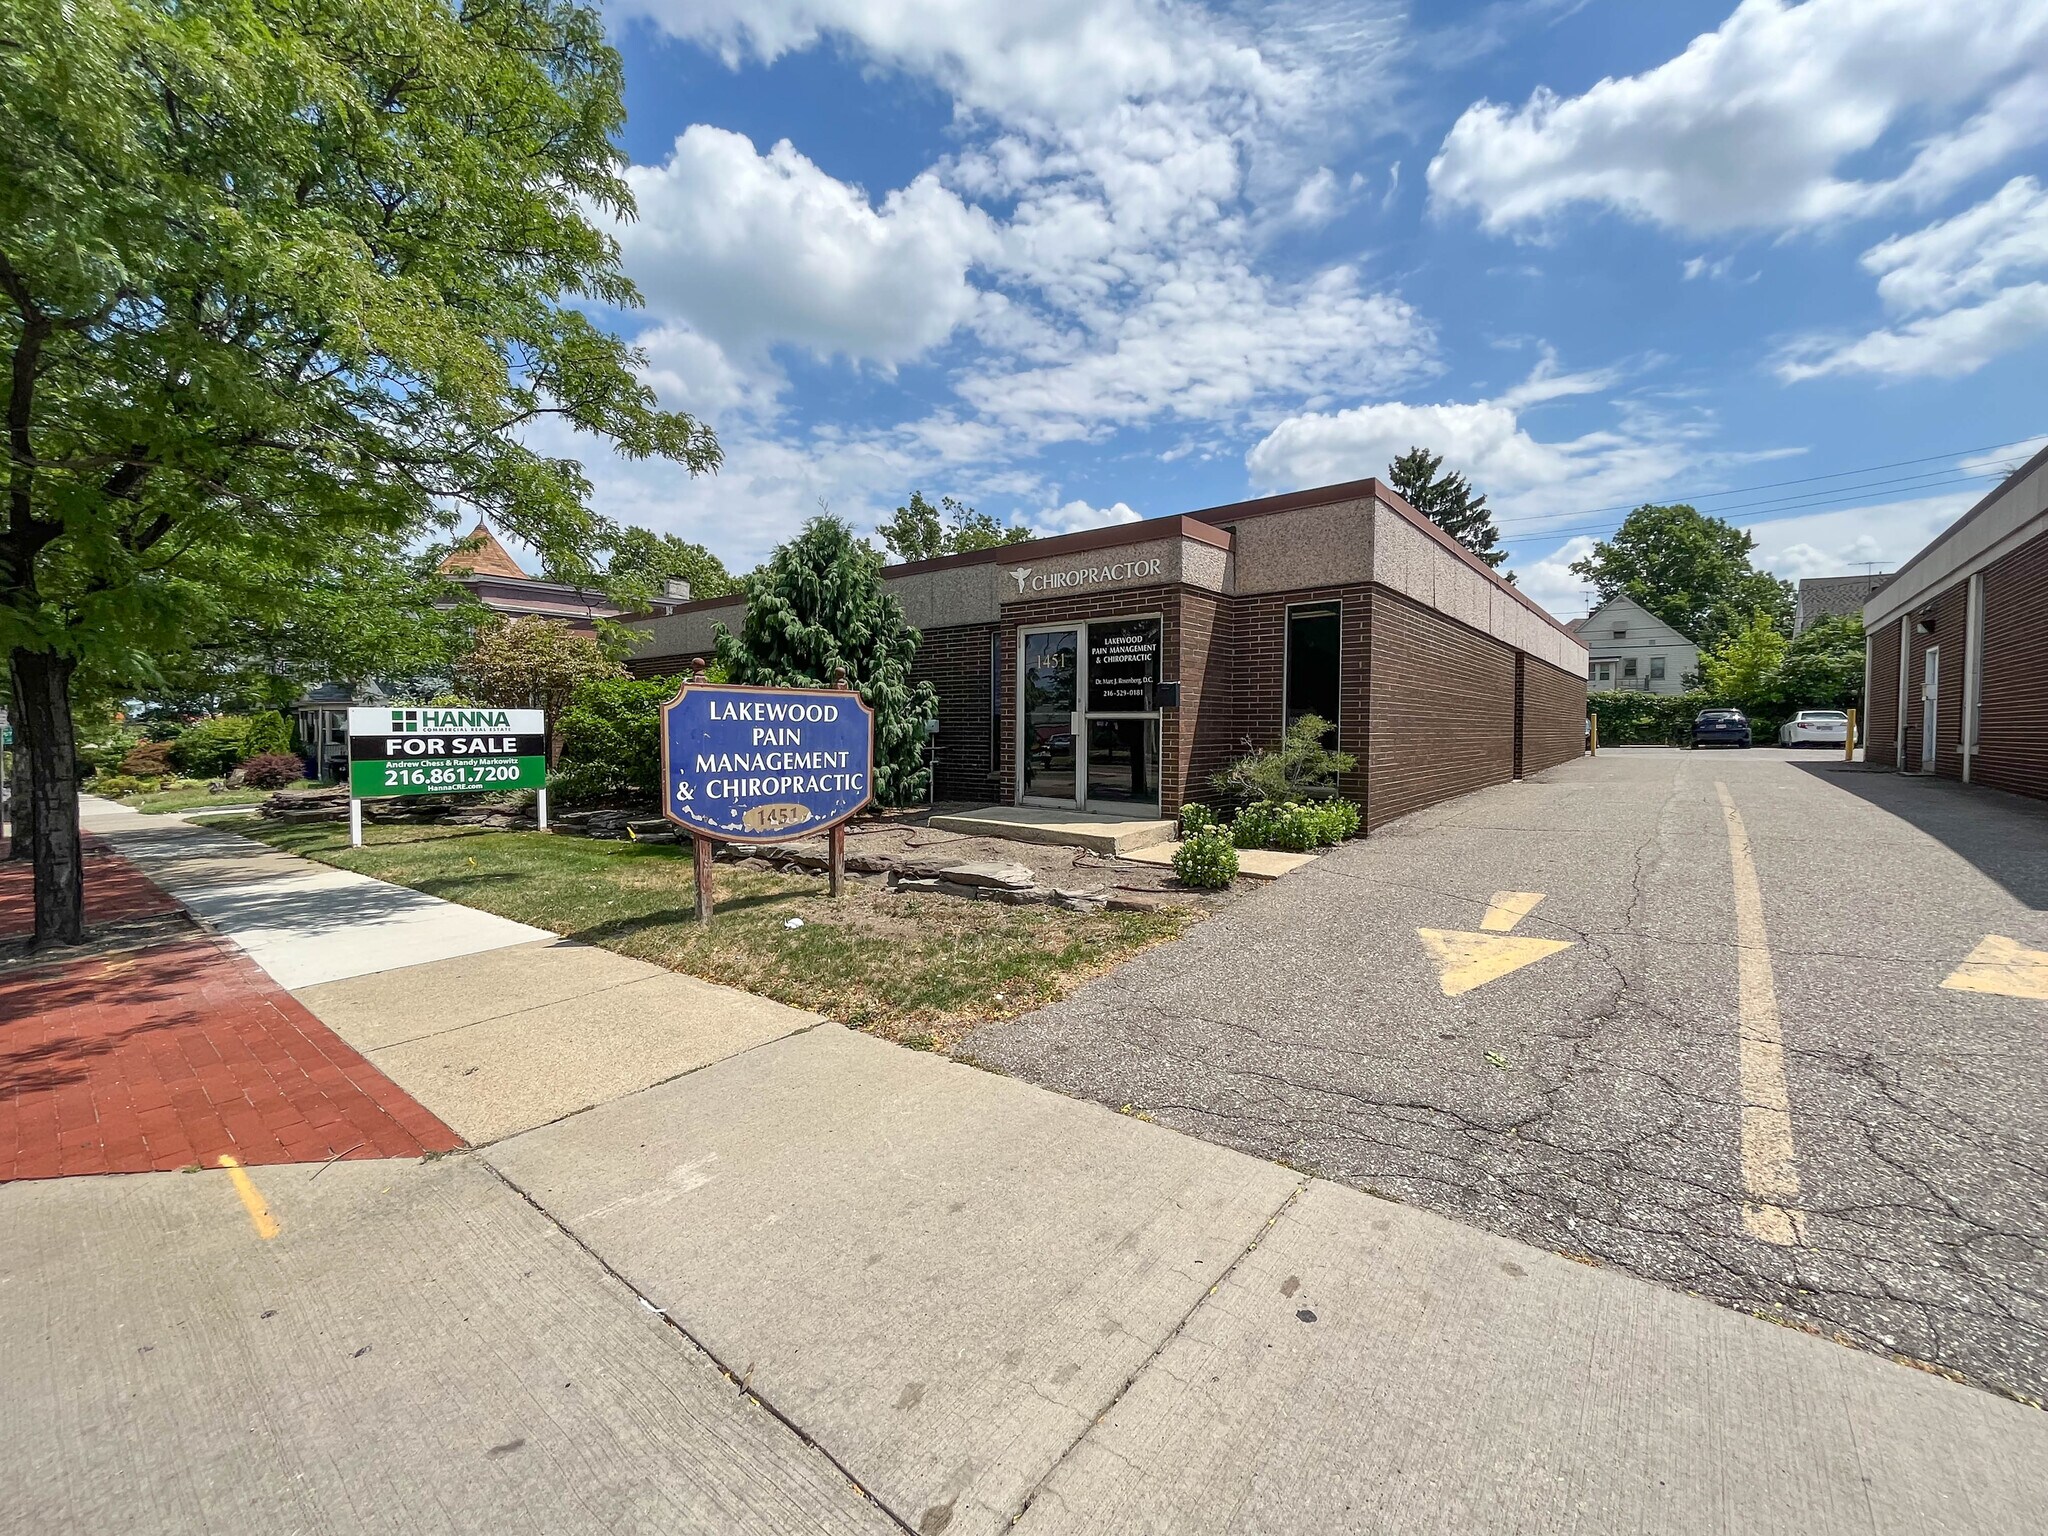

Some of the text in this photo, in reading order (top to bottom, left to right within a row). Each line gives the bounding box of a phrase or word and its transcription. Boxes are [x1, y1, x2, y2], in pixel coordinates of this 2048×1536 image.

[1032, 558, 1161, 591] CHIROPRACTOR
[1104, 635, 1143, 645] LAKEWOOD
[1091, 644, 1157, 655] PAIN MANAGEMENT
[1036, 653, 1066, 669] 1451
[1095, 653, 1152, 664] & CHIROPRACTIC
[1103, 689, 1143, 697] 216-529-0181
[422, 711, 511, 727] HANNA
[709, 701, 838, 723] LAKEWOOD
[752, 727, 801, 746] PAIN
[386, 737, 517, 755] FOR SALE
[386, 760, 419, 768] Andrew
[453, 759, 478, 767] Randy
[695, 751, 849, 773] MANAGEMENT
[384, 766, 520, 786] 216.861.7200
[428, 783, 483, 791] HannaCRE.com
[676, 773, 863, 801] & CHIROPRACTIC
[757, 807, 797, 826] 1451
